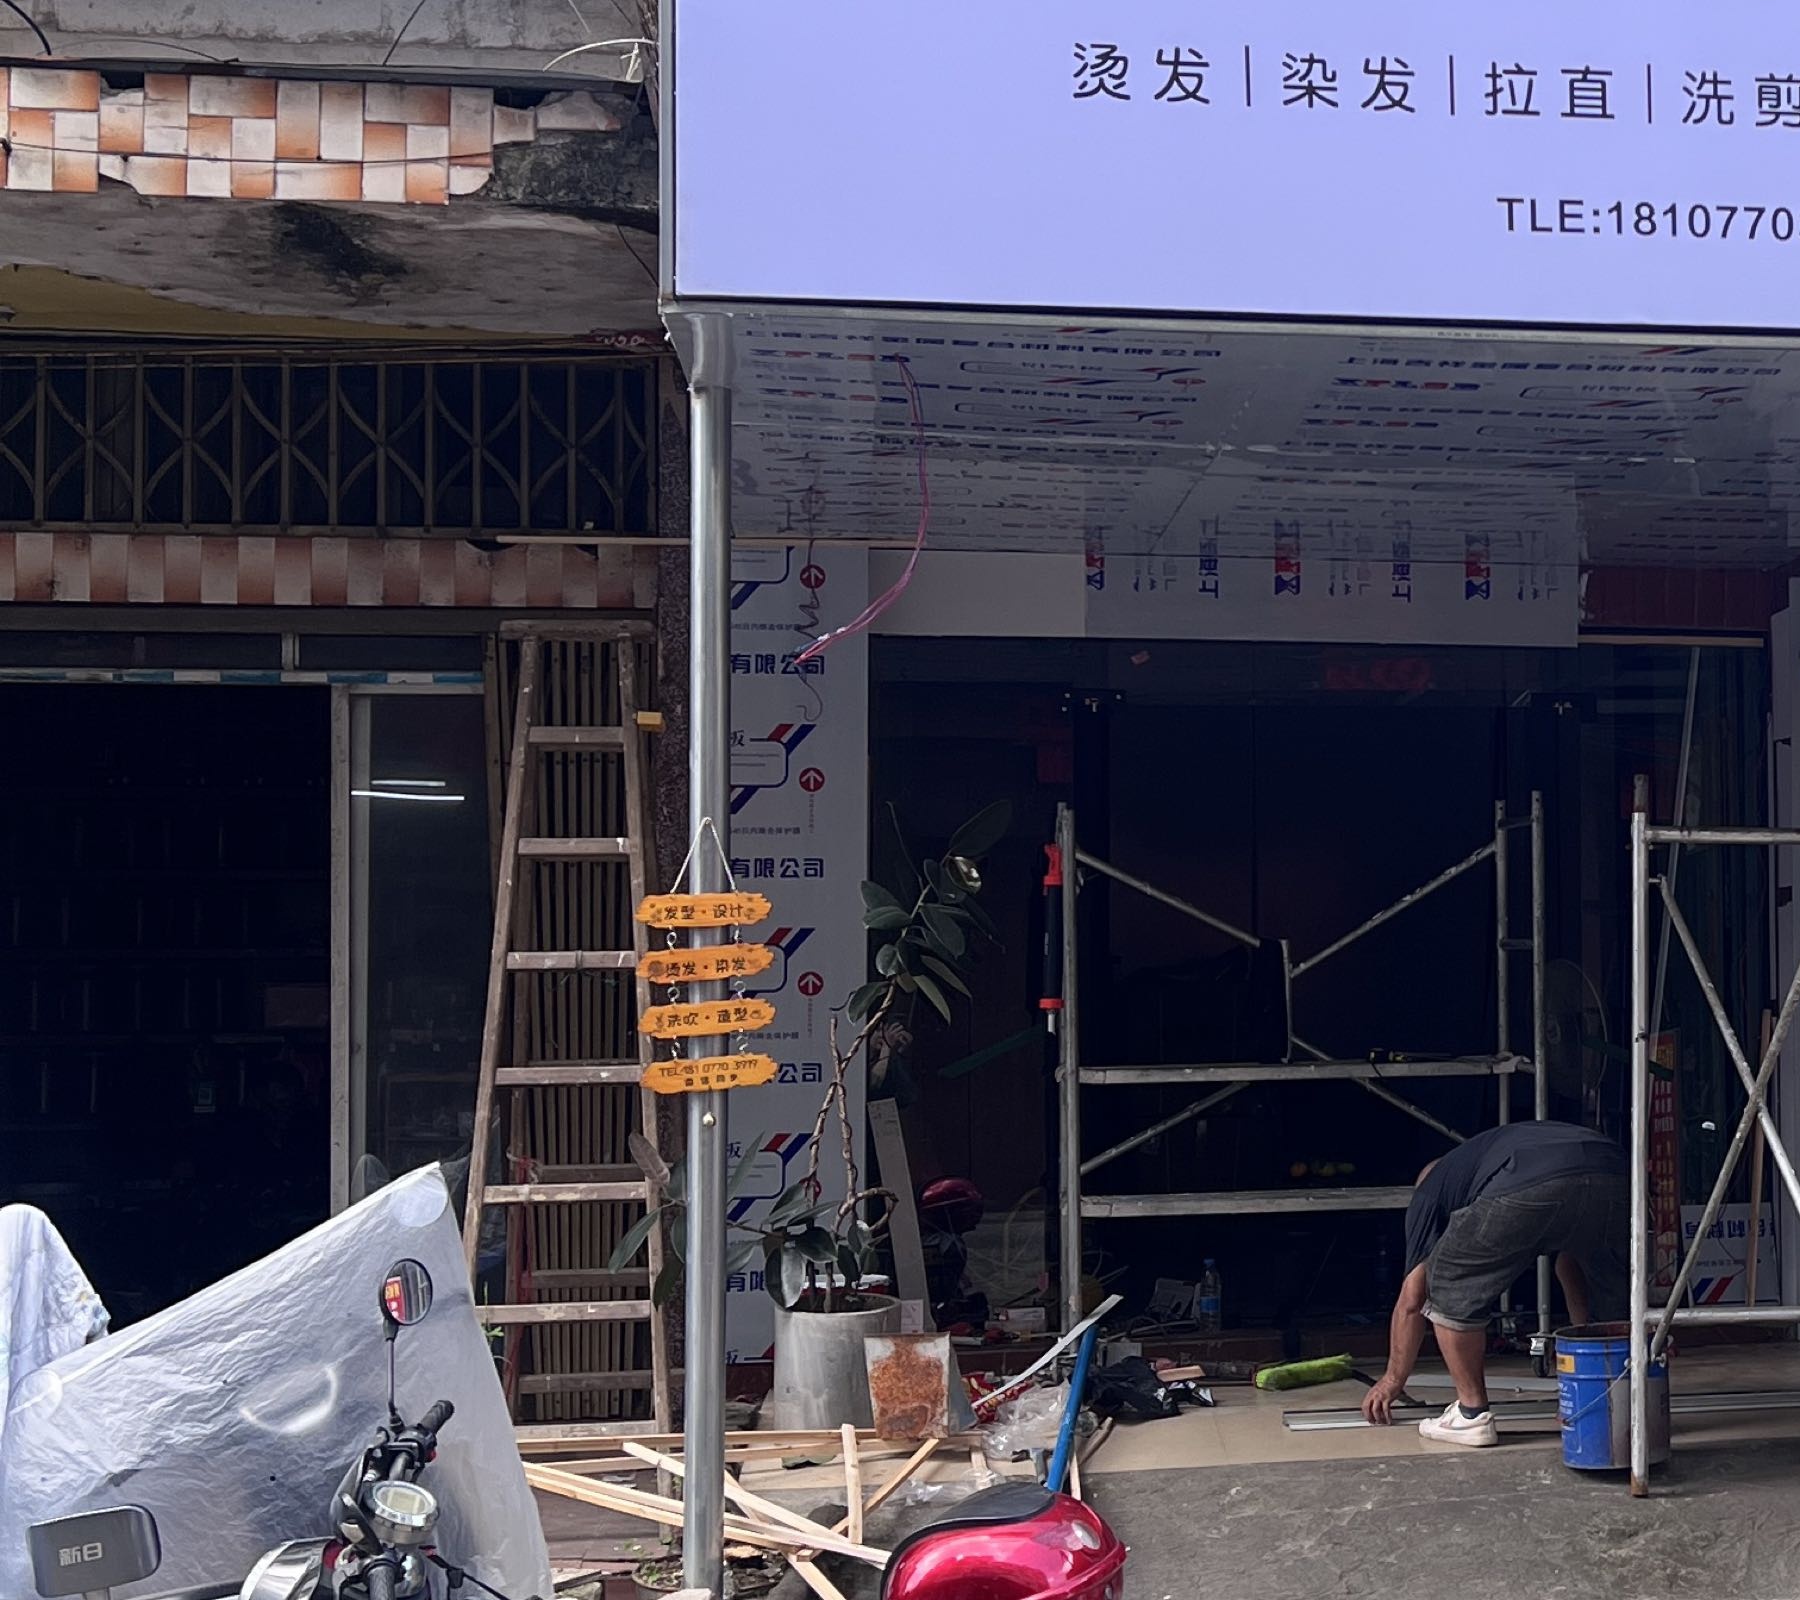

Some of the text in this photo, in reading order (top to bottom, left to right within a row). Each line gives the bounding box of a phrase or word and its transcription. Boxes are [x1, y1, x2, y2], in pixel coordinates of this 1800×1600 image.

[1072, 42, 1211, 106] 烫发
[1281, 53, 1416, 114] 染发
[1484, 61, 1616, 120] 拉直
[58, 1541, 103, 1567] 新日
